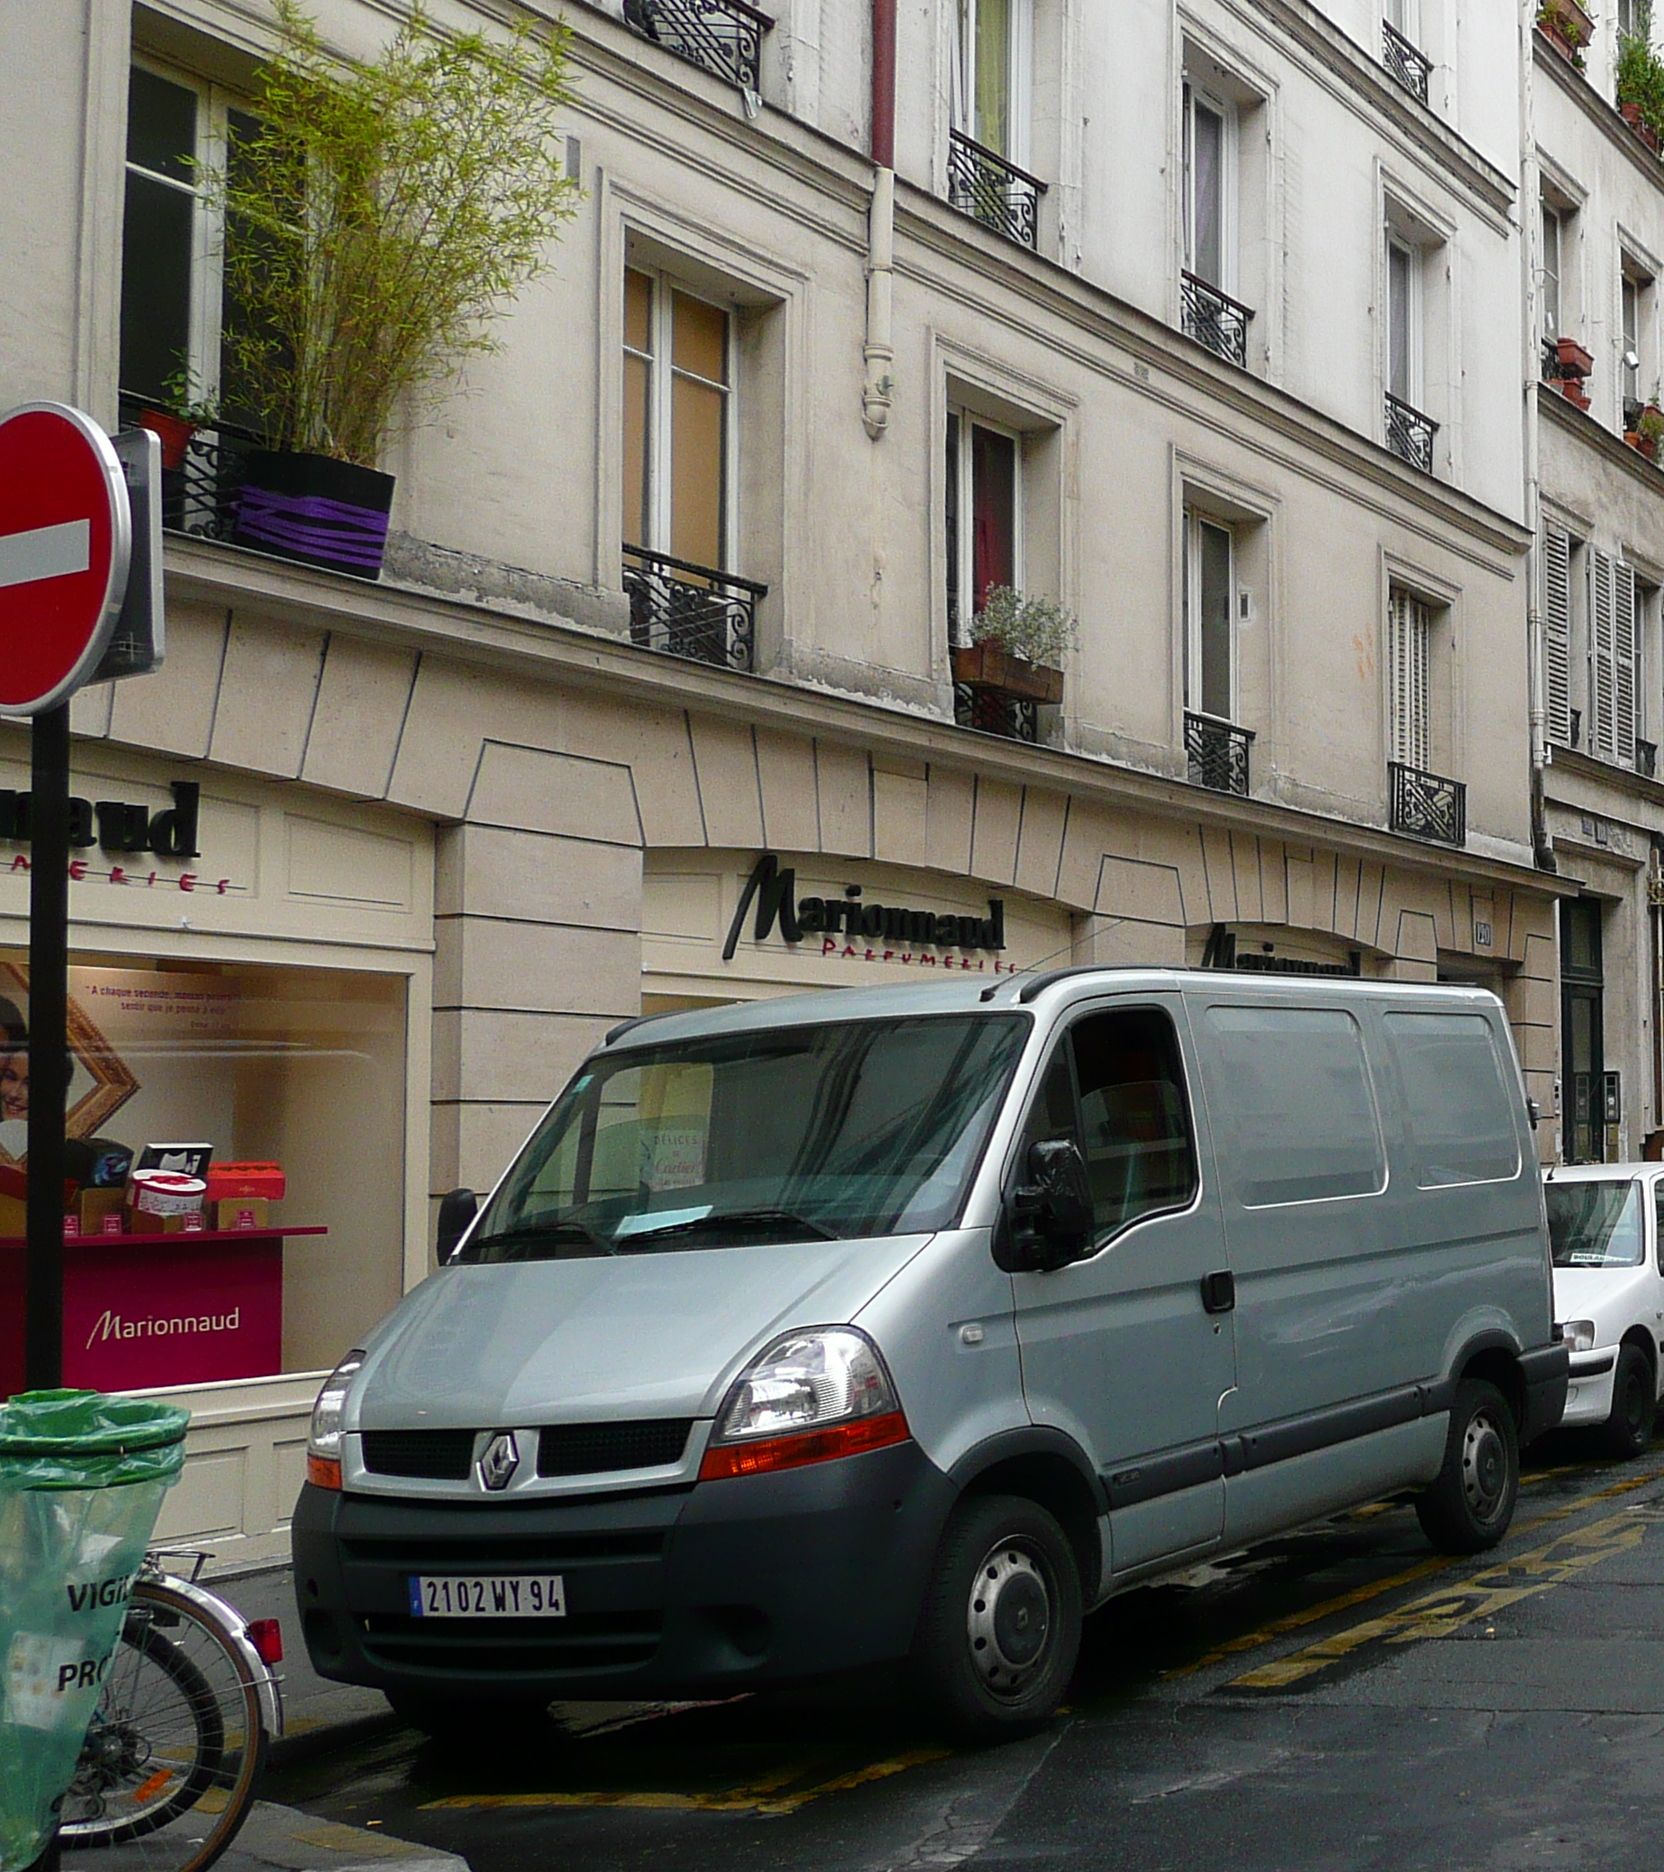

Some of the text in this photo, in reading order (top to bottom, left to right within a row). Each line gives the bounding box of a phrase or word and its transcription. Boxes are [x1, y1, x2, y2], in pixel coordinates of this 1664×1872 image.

[721, 854, 1006, 960] Marionnaud
[822, 937, 1016, 974] PARFUMERIES
[86, 1306, 239, 1350] Marionnaud
[427, 1579, 560, 1612] 2102 WY 94
